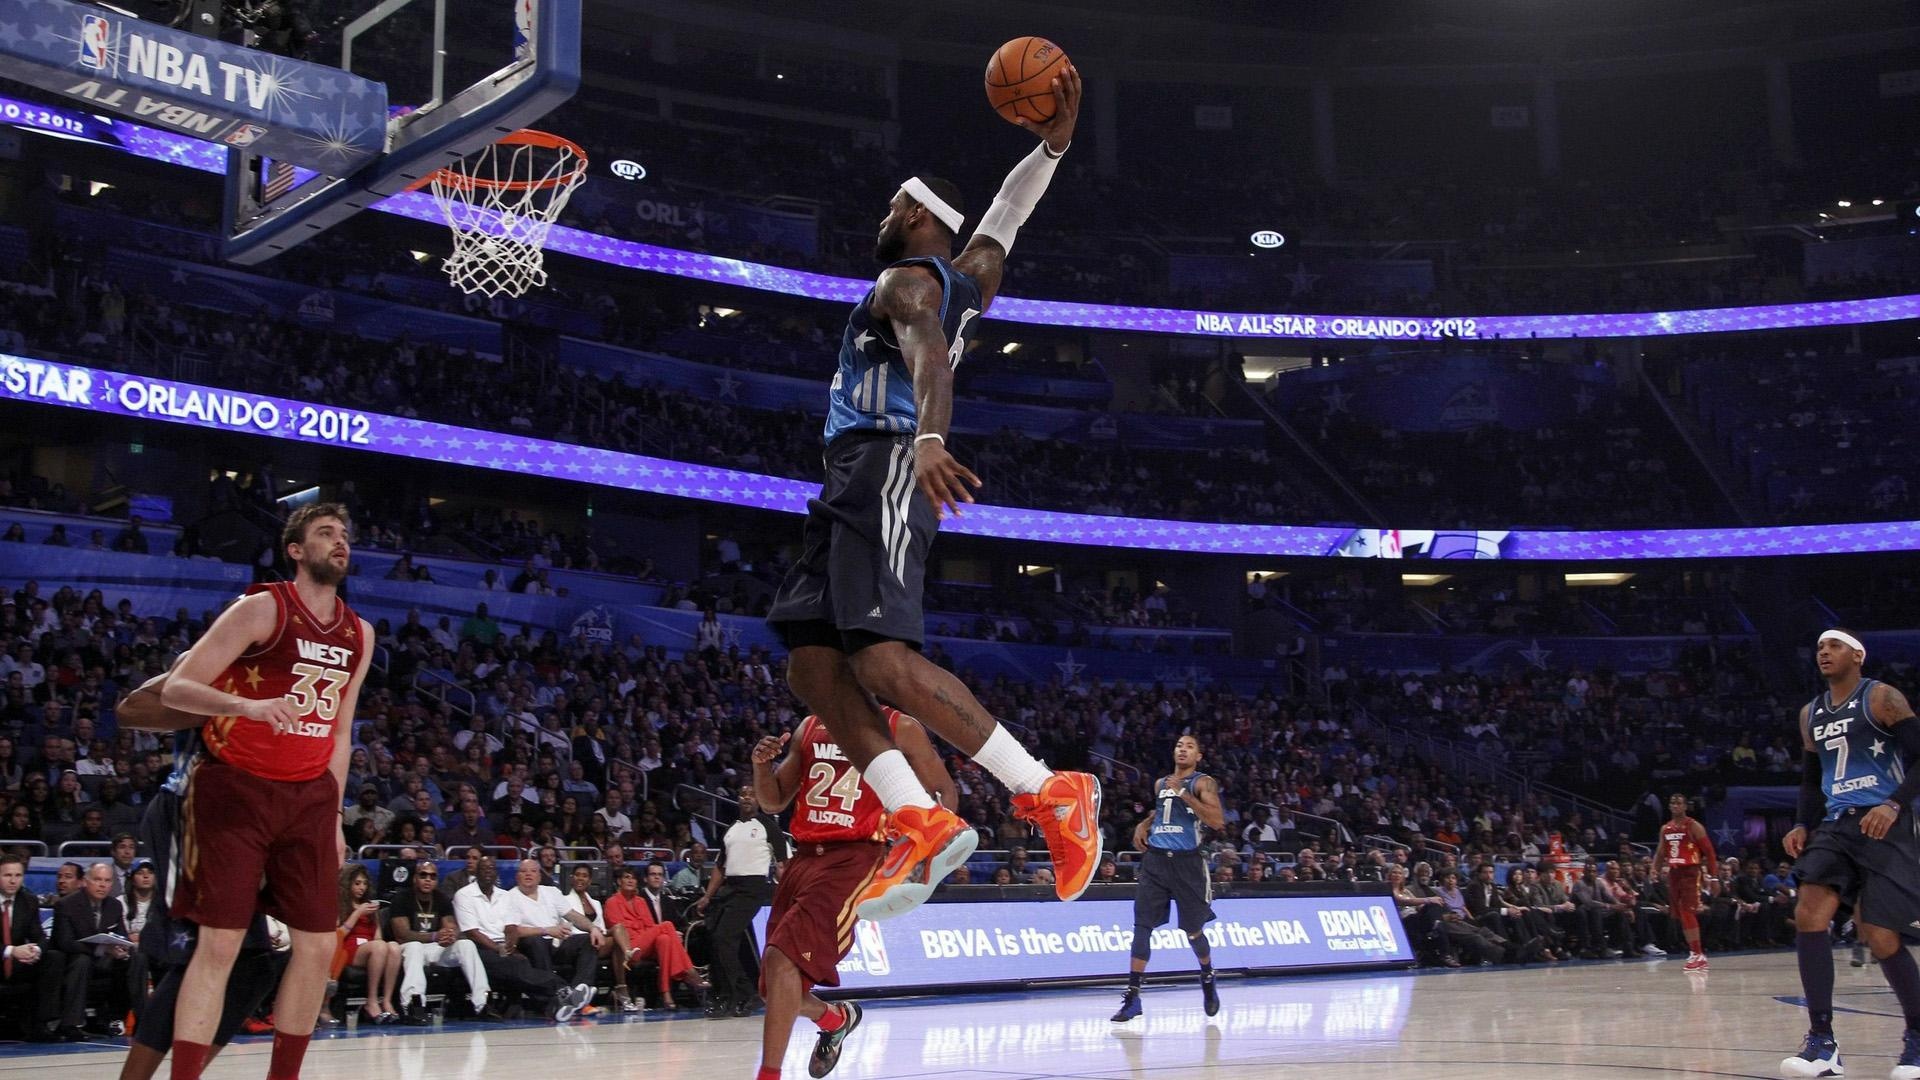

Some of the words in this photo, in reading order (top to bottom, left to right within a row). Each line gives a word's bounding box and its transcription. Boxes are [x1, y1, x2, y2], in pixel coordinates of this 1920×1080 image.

[127, 33, 212, 96] NBA
[218, 61, 273, 110] TV
[64, 80, 129, 108] TV
[38, 111, 84, 134] 2012
[133, 96, 223, 134] NBA
[614, 162, 642, 178] KIA
[1254, 232, 1282, 246] KIA
[1196, 313, 1234, 333] NBA
[1238, 315, 1317, 336] ALL-STAR
[1331, 318, 1421, 337] ORLANDO
[1432, 319, 1476, 338] 2012
[119, 380, 280, 431] ORLANDO
[300, 406, 370, 445] 2012
[296, 638, 354, 667] WEST
[284, 662, 350, 720] 33
[1813, 717, 1855, 742] EAST
[812, 742, 850, 761] WE
[1824, 735, 1849, 781] 7
[805, 761, 863, 812] 24
[1162, 798, 1173, 825] 1
[1317, 910, 1377, 937] BBVA
[920, 929, 996, 959] BBVA
[994, 928, 1021, 956] is
[1020, 927, 1064, 955] the
[1066, 924, 1135, 953] officia
[1203, 922, 1227, 948] of
[1226, 922, 1265, 947] the
[1262, 920, 1312, 945] NBA
[835, 957, 866, 973] ank
